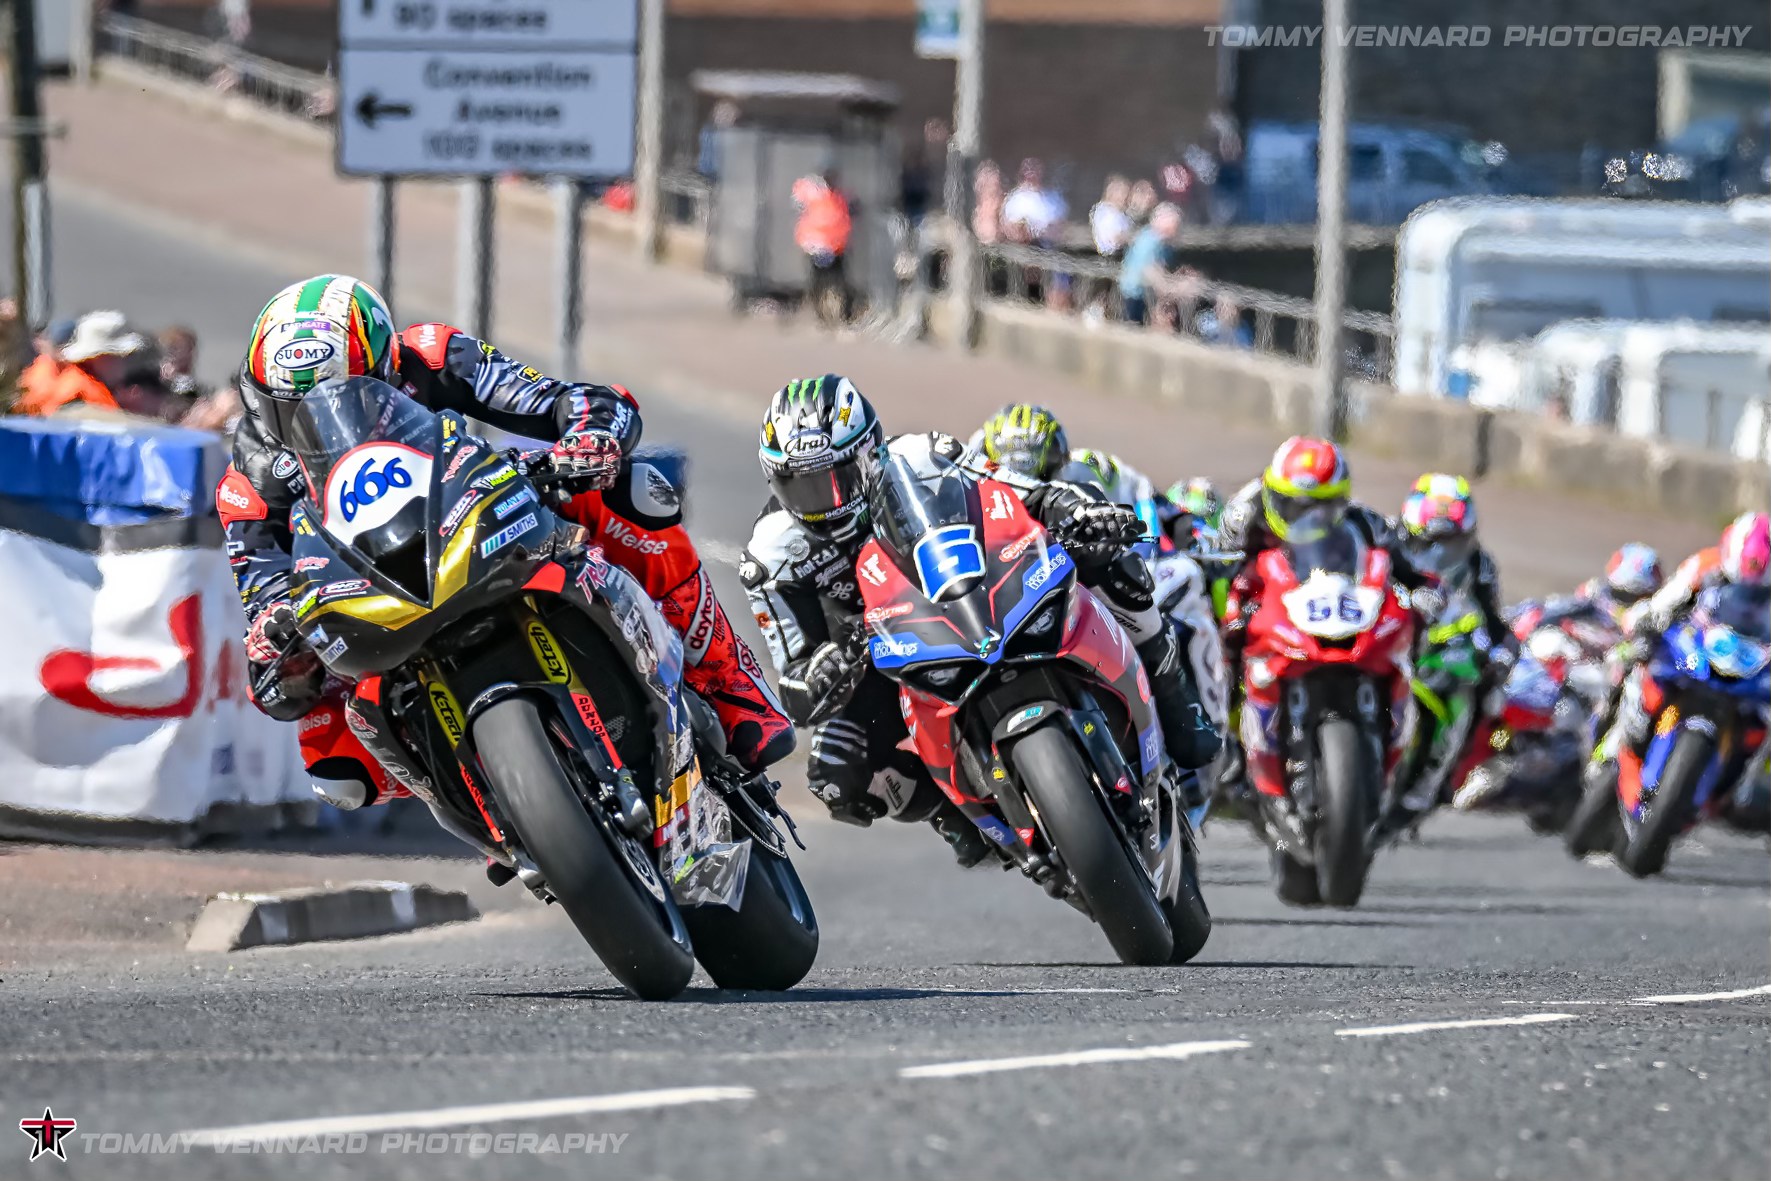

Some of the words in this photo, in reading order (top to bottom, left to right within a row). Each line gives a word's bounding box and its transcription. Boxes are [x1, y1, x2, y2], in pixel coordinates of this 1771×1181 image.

[447, 11, 546, 31] spaces
[425, 61, 591, 88] Convention
[457, 97, 560, 121] Avenue
[494, 140, 591, 160] spaces
[278, 348, 329, 360] SUOMY
[789, 434, 825, 453] Arai
[340, 457, 412, 523] 666
[507, 515, 536, 538] SMITHS
[604, 517, 668, 555] Weise
[914, 524, 985, 603] 6
[579, 697, 606, 738] DUNLOP
